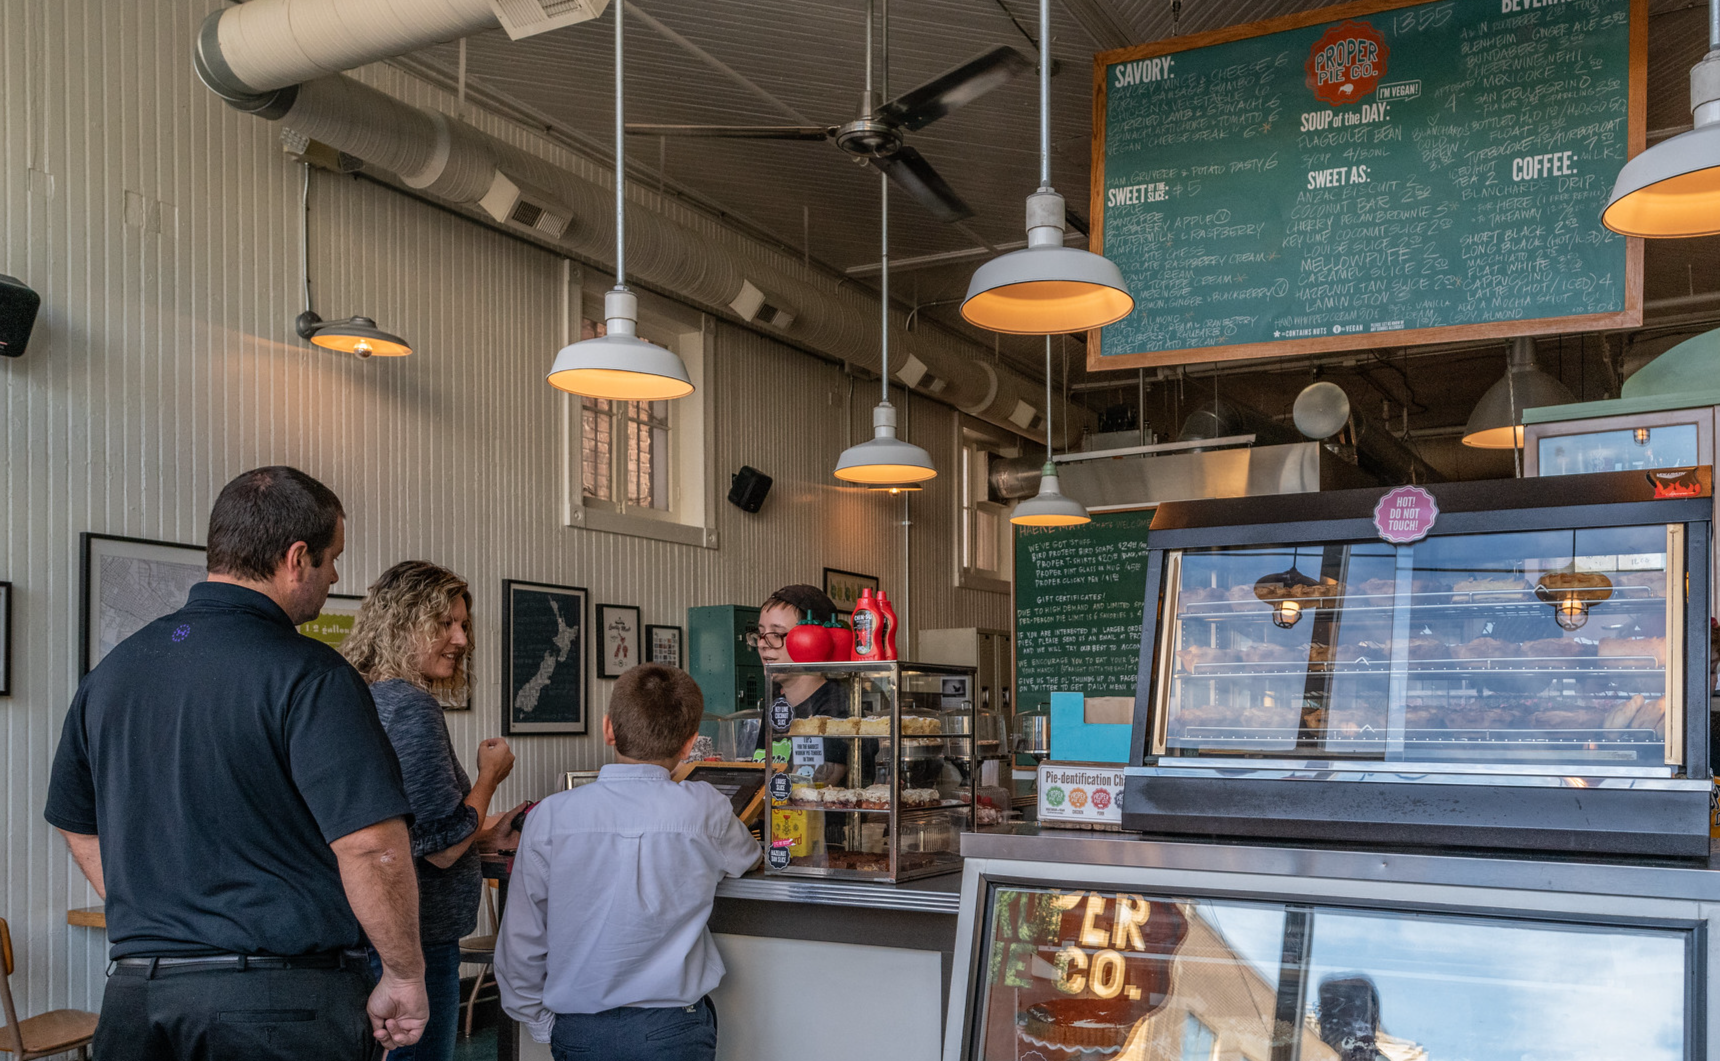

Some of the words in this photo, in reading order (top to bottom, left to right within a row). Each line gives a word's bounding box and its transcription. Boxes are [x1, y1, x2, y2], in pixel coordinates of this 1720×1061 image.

[1572, 17, 1600, 33] ALE
[1315, 38, 1379, 72] PROPER
[1466, 39, 1549, 69] BUNDABERG
[1115, 56, 1175, 88] SAVORY:
[1211, 58, 1271, 81] CHEESE
[1275, 51, 1289, 67] 6
[1260, 68, 1275, 84] 6
[1317, 68, 1346, 86] PIE
[1350, 63, 1379, 80] CO.
[1379, 87, 1391, 99] I'M
[1391, 83, 1420, 98] VEGAN!
[1269, 108, 1283, 122] 6
[1300, 110, 1334, 132] SOUP
[1332, 112, 1343, 128] of
[1344, 110, 1361, 126] the
[1361, 101, 1391, 124] DAY:
[1373, 125, 1402, 143] BEAN
[1191, 163, 1227, 177] POTATO
[1512, 150, 1578, 181] COFFEE:
[1306, 167, 1348, 190] SWEET
[1349, 165, 1372, 184] AS:
[1485, 171, 1499, 186] 2
[1107, 184, 1148, 207] SWEET
[1148, 183, 1156, 192] BY
[1157, 181, 1167, 191] THE
[1341, 180, 1400, 200] BISCUIT
[1406, 174, 1419, 187] 2
[1290, 200, 1352, 220] COCONUT
[1356, 195, 1391, 214] BAR
[1174, 214, 1214, 229] APPLE
[1286, 215, 1334, 235] CHERRY
[1374, 204, 1432, 223] BROWNIE
[1190, 222, 1265, 241] RASPBERRY
[1282, 233, 1303, 249] KEY
[1336, 223, 1388, 241] COCONUT
[1388, 220, 1428, 236] SLICE
[1504, 225, 1545, 242] BLACK
[1353, 237, 1391, 253] SLICE
[1461, 242, 1497, 260] LONG
[1501, 237, 1544, 253] BLACK
[1229, 252, 1267, 265] CREAM
[1301, 247, 1411, 273] MELLOWPUFF
[1424, 241, 1440, 258] 2
[1157, 269, 1195, 281] CREAM
[1297, 266, 1364, 286] CARAMEL
[1371, 261, 1416, 278] SLICE
[1468, 264, 1502, 281] FLAT
[1506, 258, 1551, 275] WHITE
[1295, 281, 1358, 301] HAZELNUT
[1360, 279, 1388, 295] TAN
[1467, 285, 1510, 301] LATTE
[1482, 308, 1524, 321] ALMOND
[1396, 496, 1416, 507] HOT!
[1389, 508, 1401, 519] DO
[1402, 508, 1420, 519] NOT
[1388, 520, 1419, 531] TOUCH!
[1052, 539, 1067, 549] GOT
[1036, 559, 1064, 569] PROPER
[1035, 568, 1062, 578] PROPER
[1035, 577, 1061, 588] PROPER
[1036, 595, 1054, 604] GIFT
[1062, 602, 1089, 612] DEMAND
[1039, 629, 1051, 638] ARE
[1102, 624, 1126, 633] LARGER
[1070, 682, 1084, 691] GET
[1086, 681, 1107, 691] DAILY
[1045, 770, 1112, 787] Pie-dentification
